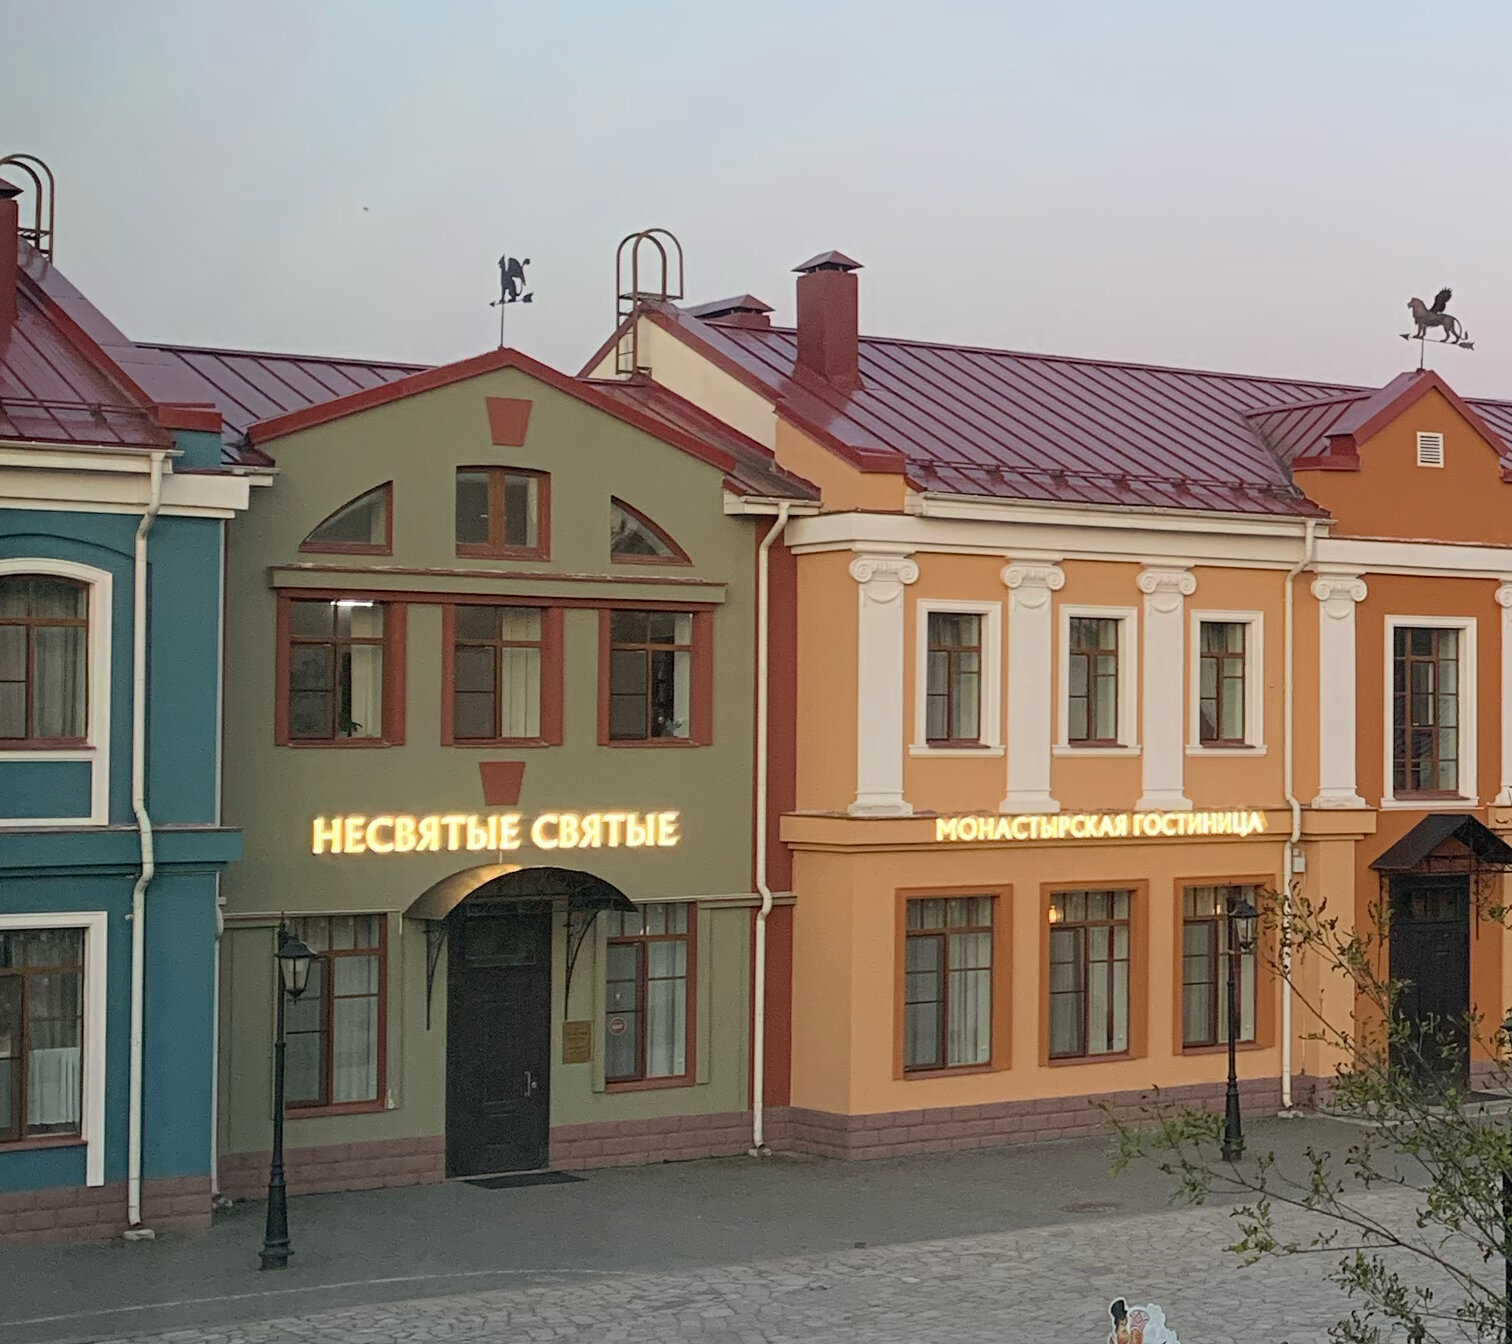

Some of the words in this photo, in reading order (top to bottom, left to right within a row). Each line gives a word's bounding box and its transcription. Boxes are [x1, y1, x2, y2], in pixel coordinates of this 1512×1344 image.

[312, 813, 519, 854] НЕСВЯТЫЕ
[531, 811, 680, 848] СВЯТЫЕ
[936, 814, 1127, 841] МОНАСТЫРСКАЯ
[1133, 810, 1264, 837] ГОСТИНИЦА
